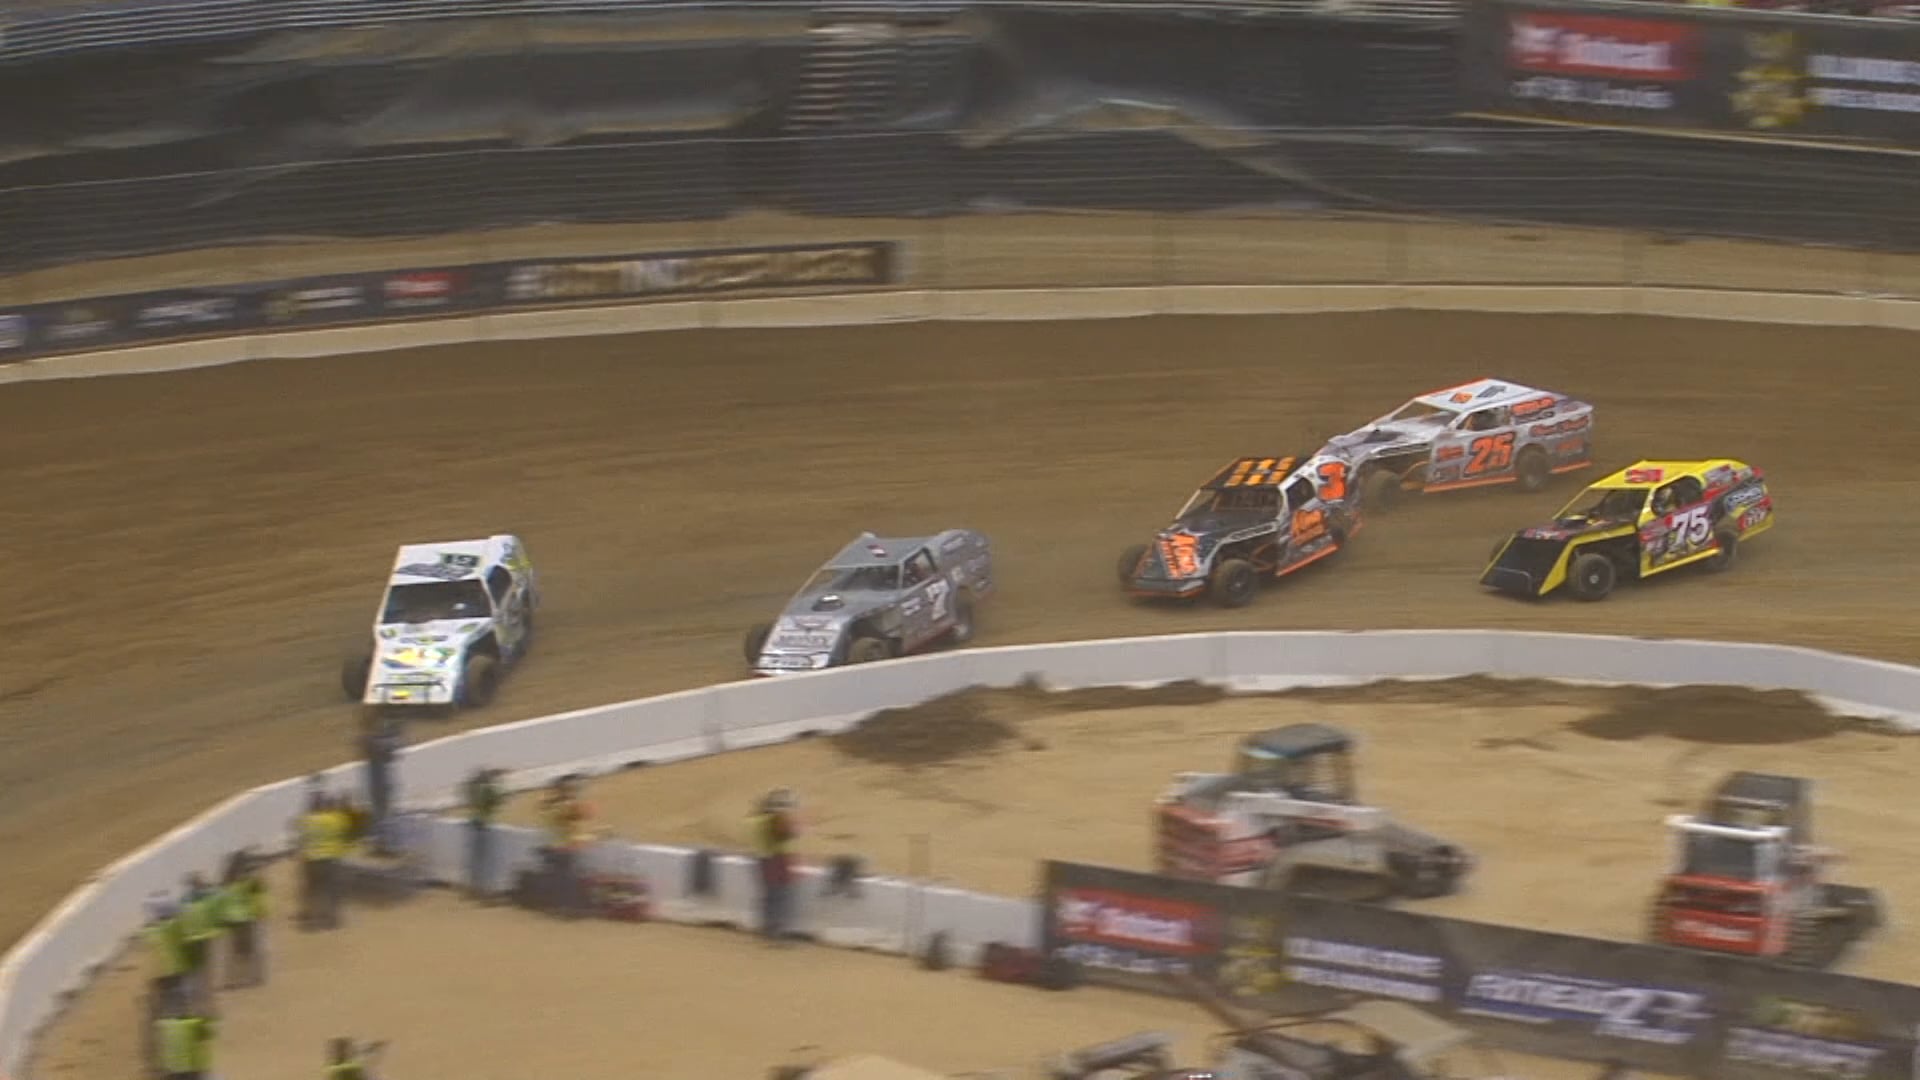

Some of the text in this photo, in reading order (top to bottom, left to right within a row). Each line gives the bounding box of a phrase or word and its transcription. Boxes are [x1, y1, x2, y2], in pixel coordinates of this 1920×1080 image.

[1465, 431, 1516, 475] 25
[1316, 462, 1346, 501] 3
[1672, 505, 1710, 547] 75
[925, 578, 950, 622] 7
